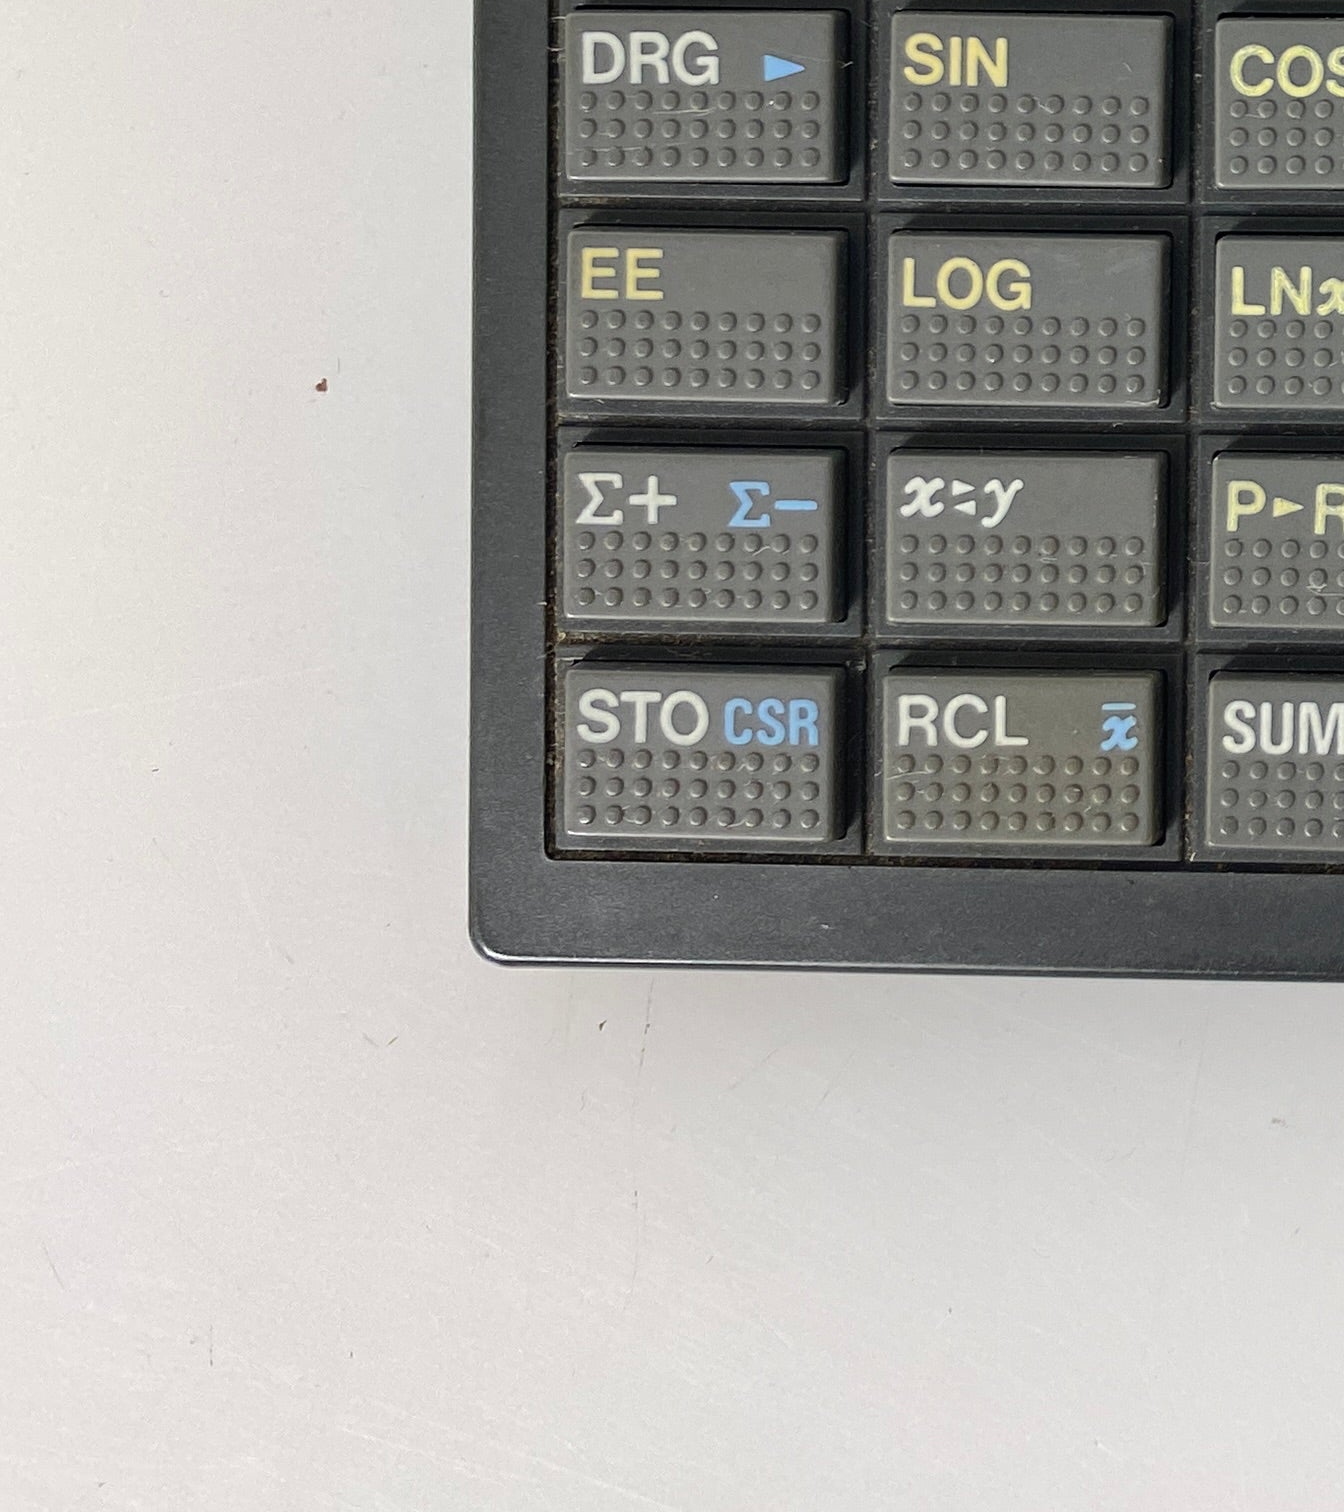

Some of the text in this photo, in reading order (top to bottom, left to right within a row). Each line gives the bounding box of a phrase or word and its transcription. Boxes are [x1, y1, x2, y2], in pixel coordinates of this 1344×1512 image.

[583, 30, 718, 85] DRG
[904, 33, 1007, 87] SIN
[581, 248, 663, 299] EE
[903, 257, 1031, 310] LOG
[577, 687, 818, 745] STO CSR
[898, 694, 1028, 748] RCL
